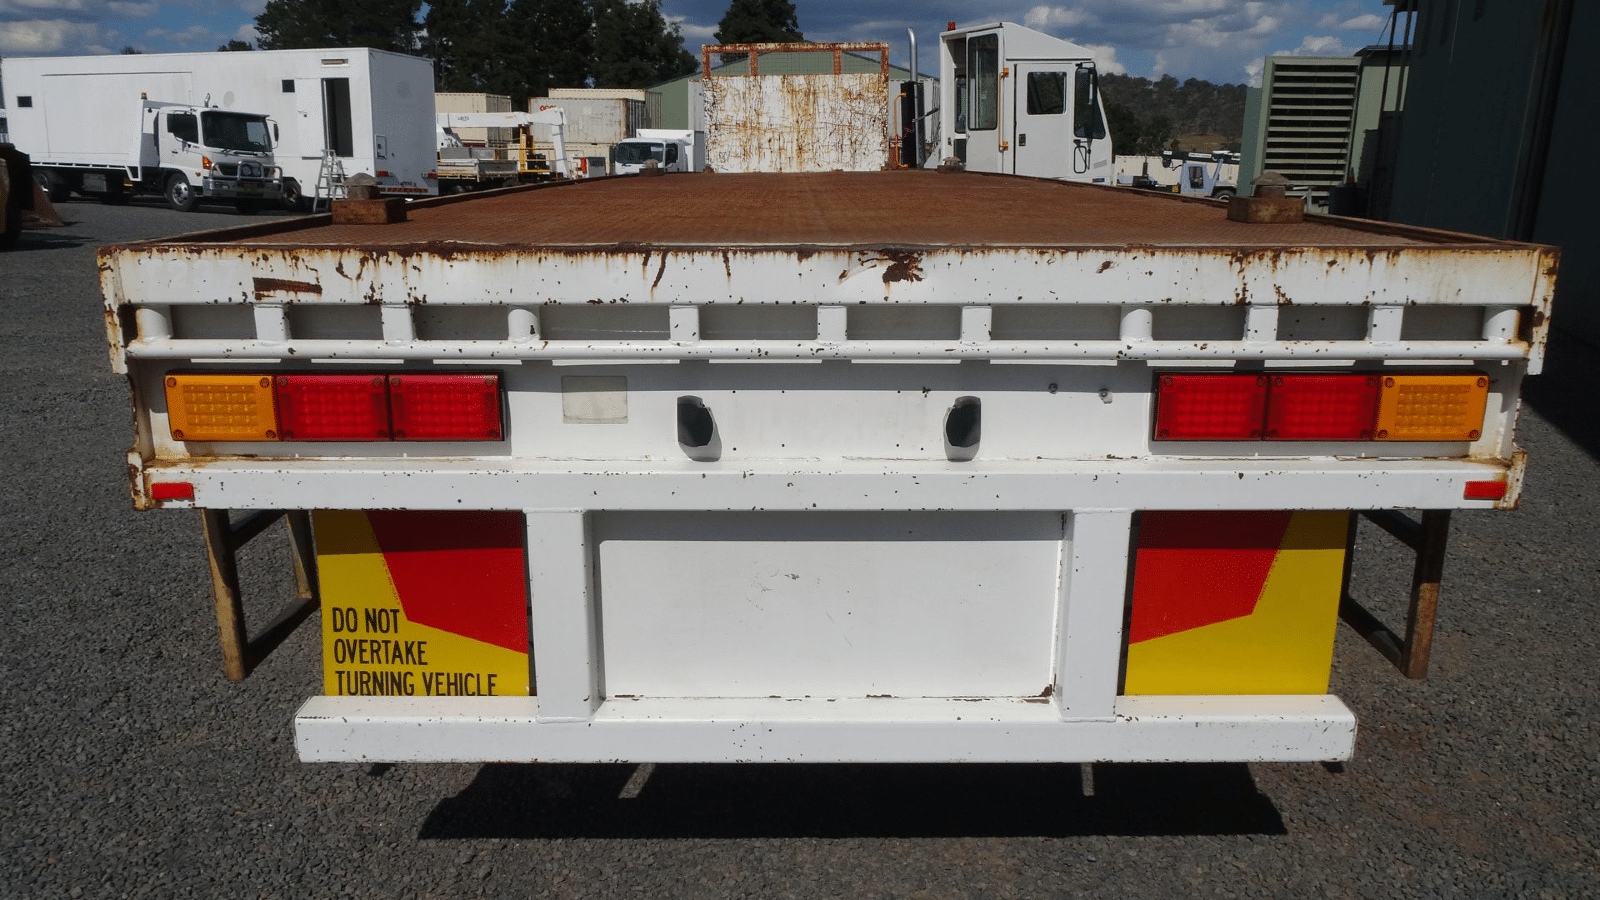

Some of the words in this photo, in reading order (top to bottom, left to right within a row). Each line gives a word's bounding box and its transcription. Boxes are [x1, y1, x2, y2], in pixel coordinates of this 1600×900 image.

[332, 607, 358, 633] DO
[364, 608, 400, 634] NOT
[334, 638, 428, 665] OVERTAKE
[335, 670, 415, 696] TURNING
[422, 672, 498, 696] VEHICLE
